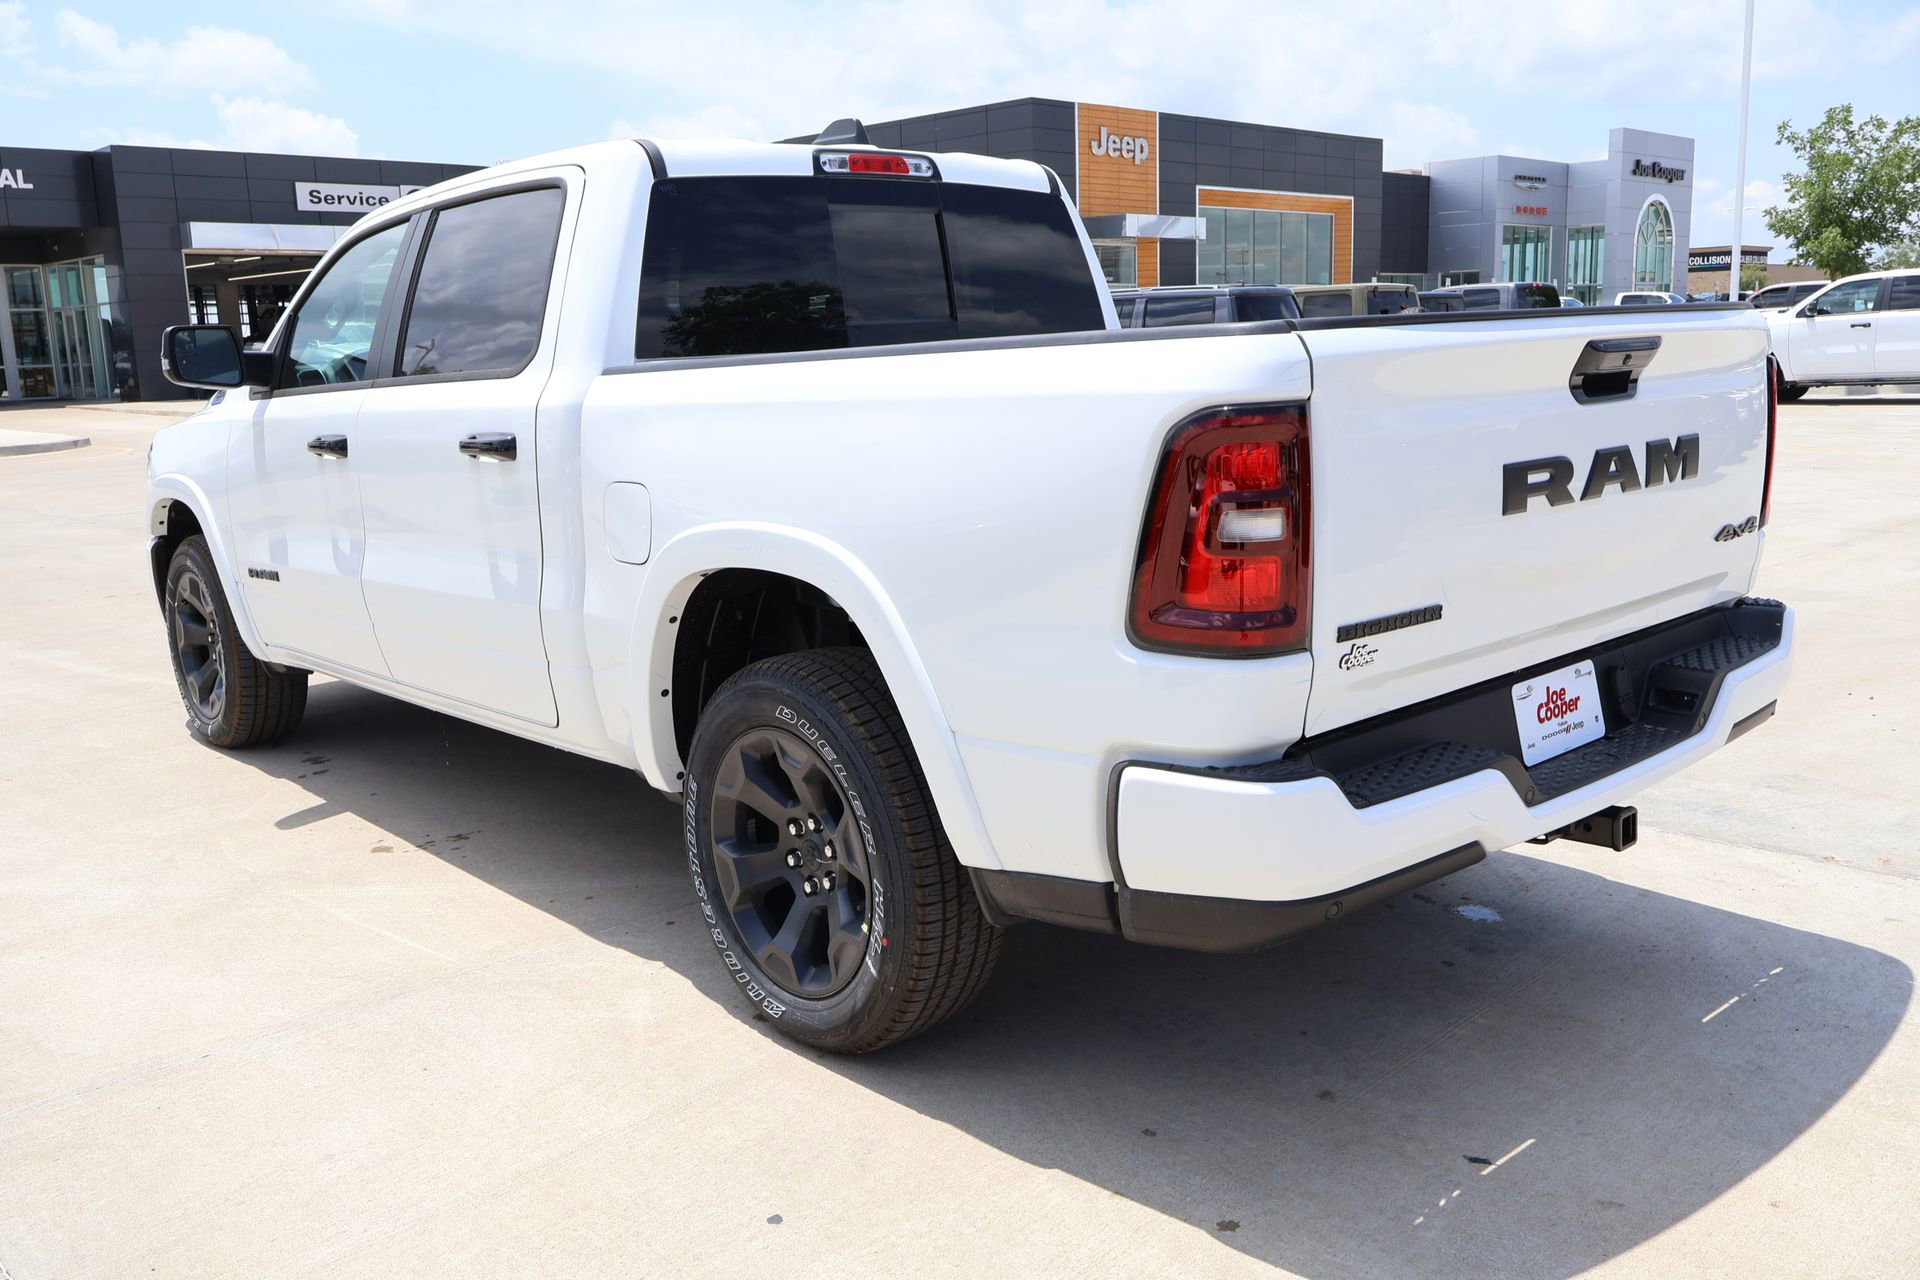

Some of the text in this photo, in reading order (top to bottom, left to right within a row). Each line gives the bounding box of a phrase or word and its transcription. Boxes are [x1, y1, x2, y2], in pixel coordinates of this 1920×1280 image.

[1091, 126, 1149, 165] Jeep
[1632, 159, 1687, 183] Joe Cooper
[308, 189, 390, 207] Service
[1689, 255, 1731, 266] COLLISION
[1502, 432, 1700, 516] RAM
[1714, 515, 1758, 542] 4x4
[1339, 649, 1378, 670] Cooper
[1349, 643, 1369, 658] Joe
[1544, 686, 1566, 707] Joe
[1537, 696, 1580, 724] Cooper
[1572, 720, 1585, 731] Jeep
[776, 704, 876, 856] DUELER
[684, 774, 787, 1018] BRIDGESTONE
